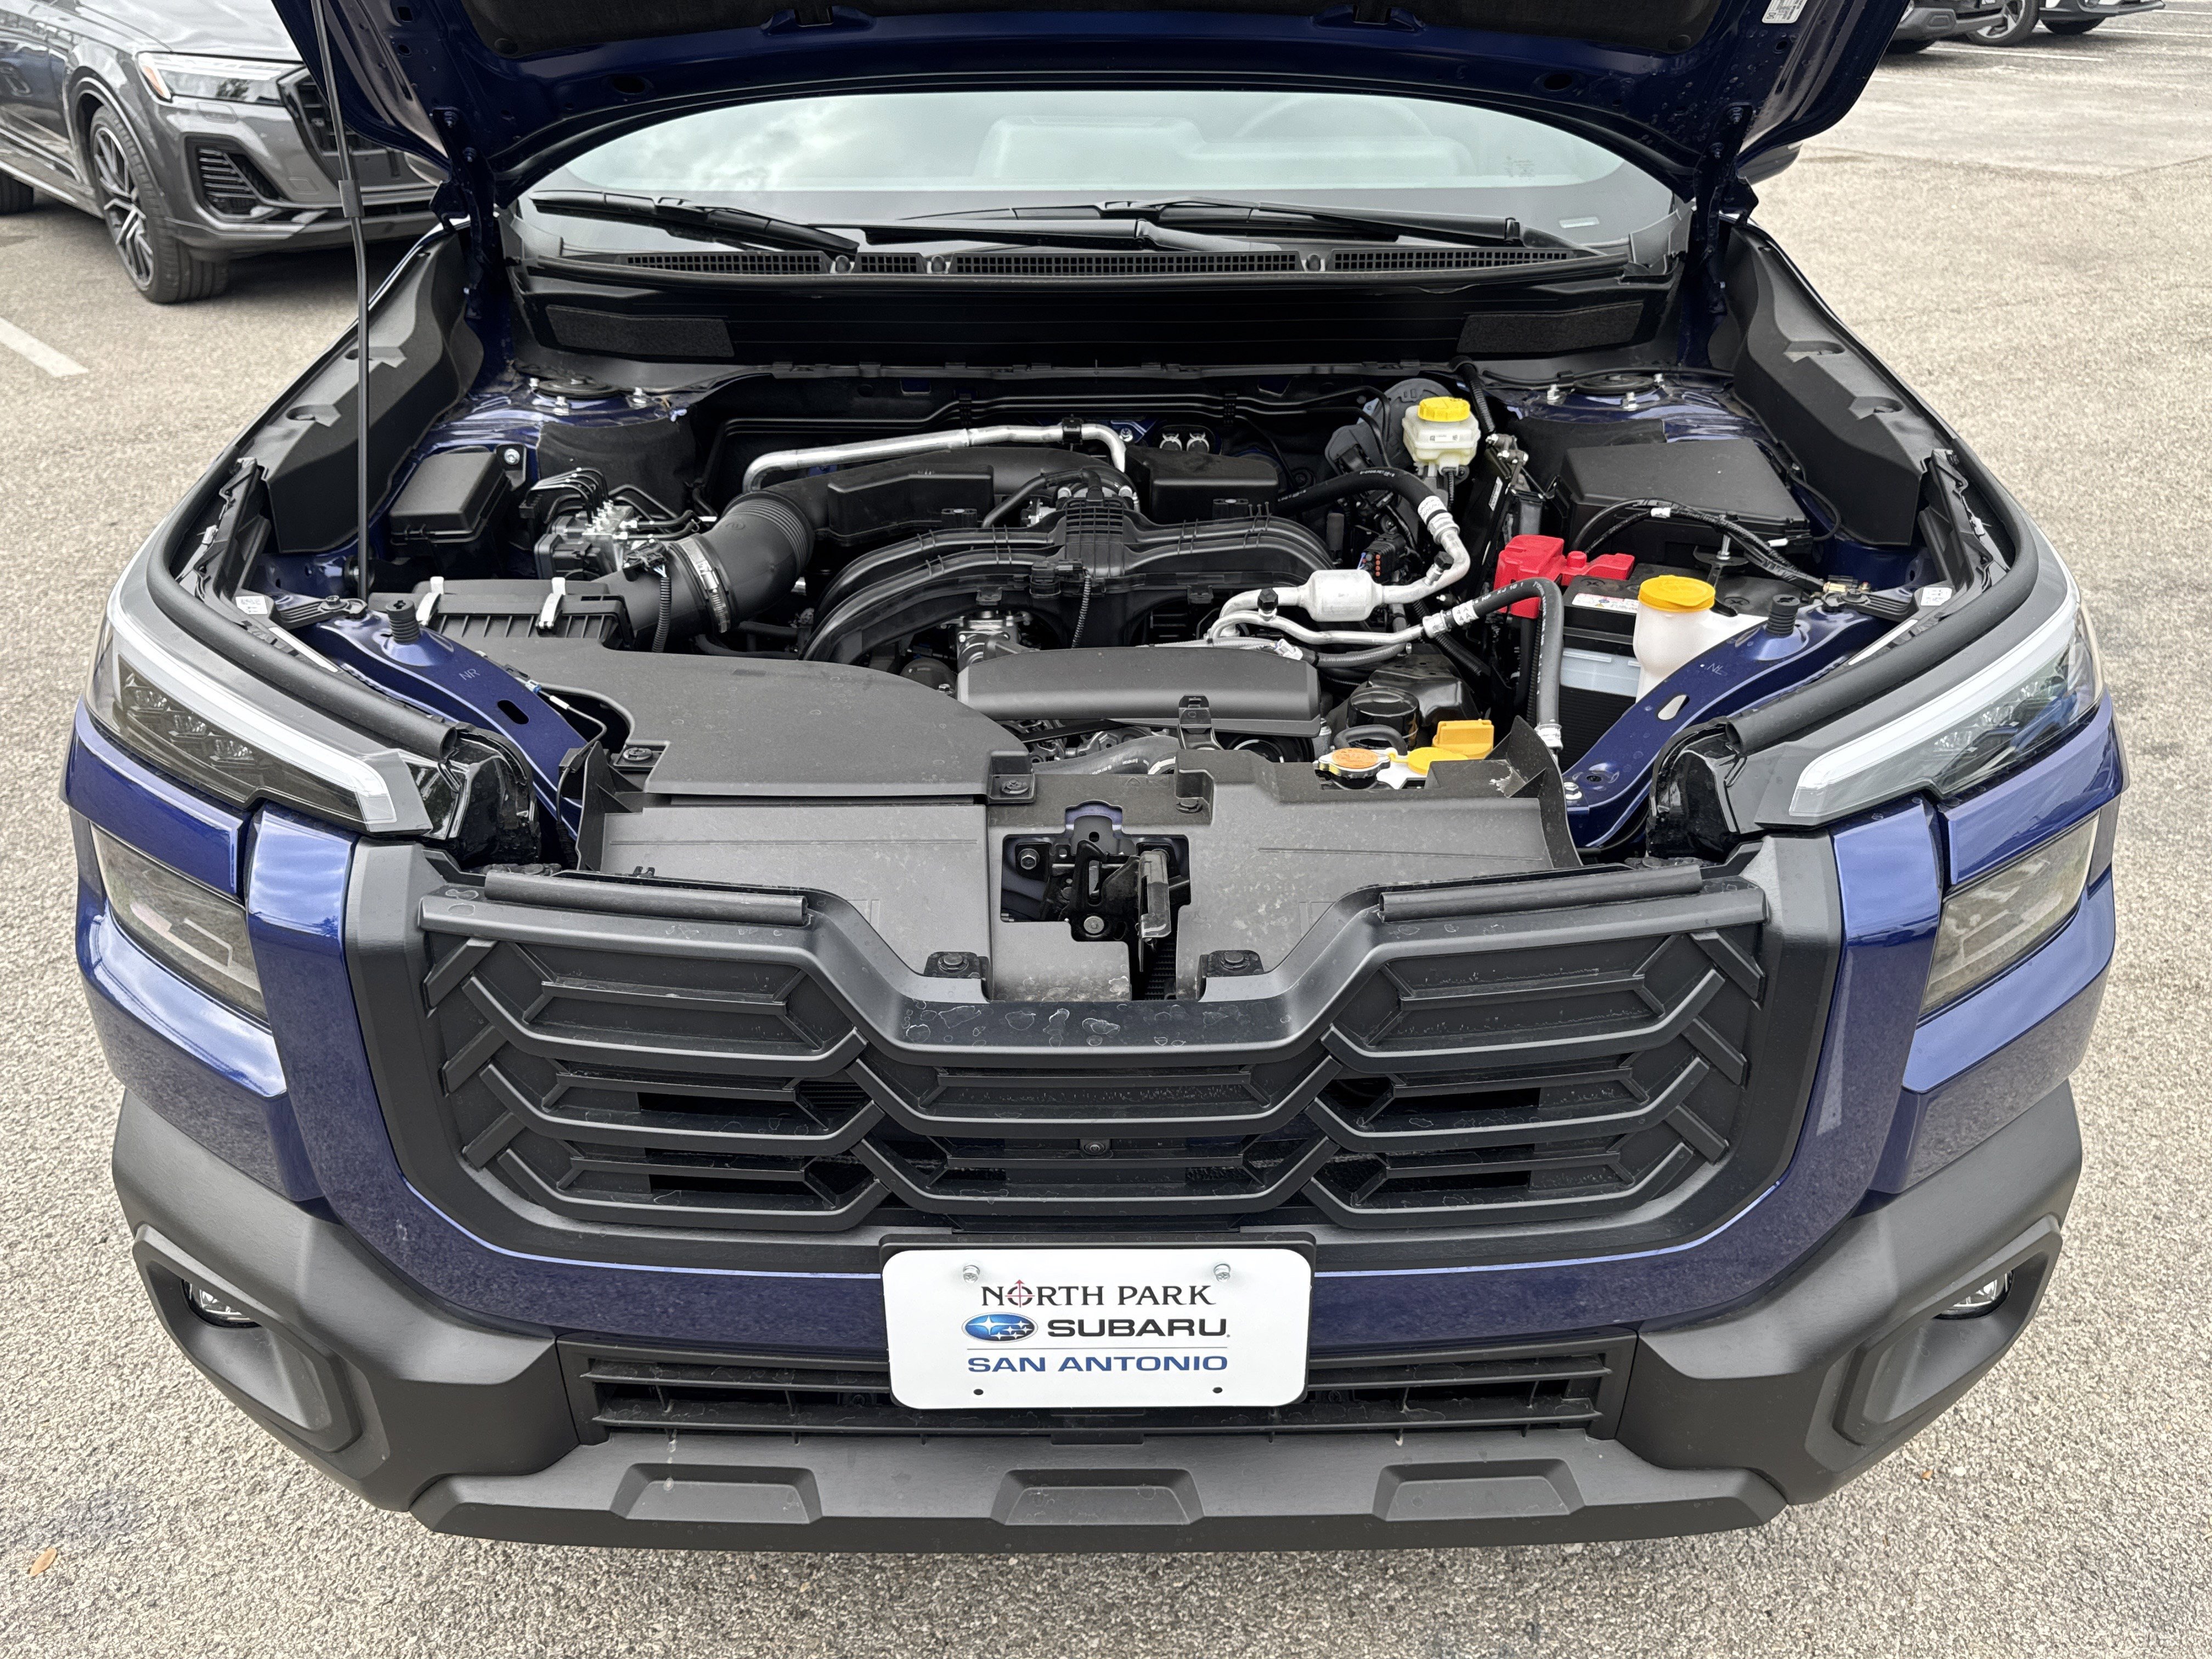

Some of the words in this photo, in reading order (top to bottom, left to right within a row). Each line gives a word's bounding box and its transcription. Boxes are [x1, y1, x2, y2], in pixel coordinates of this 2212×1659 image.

[459, 668, 481, 680] NR
[981, 1283, 1104, 1306] NORTH
[1117, 1285, 1216, 1306] PARK
[1047, 1318, 1228, 1337] SUBARU
[968, 1357, 1046, 1373] SAN
[1058, 1355, 1228, 1372] ANTONIO
